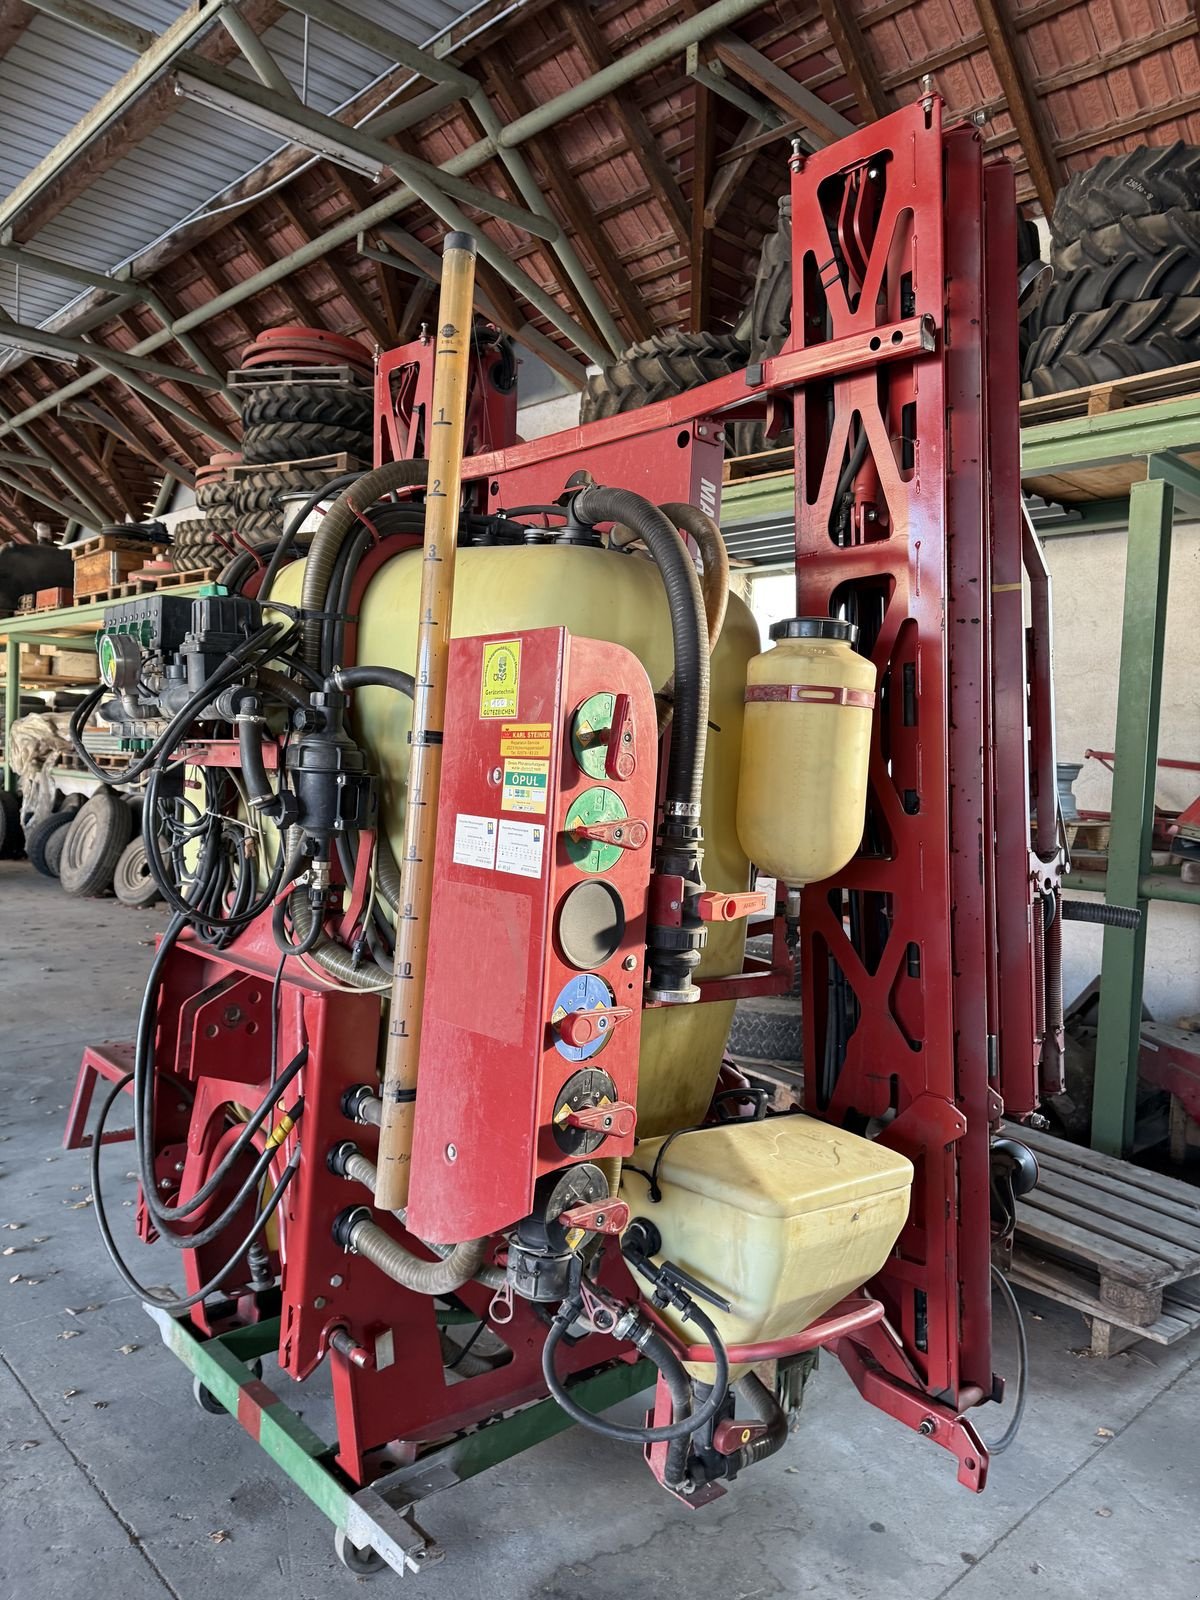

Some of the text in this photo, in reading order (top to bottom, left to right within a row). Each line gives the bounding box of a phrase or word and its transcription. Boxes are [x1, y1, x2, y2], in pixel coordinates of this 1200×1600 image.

[439, 408, 445, 421] 1
[433, 479, 441, 492] 2
[429, 544, 436, 557] 3
[426, 608, 432, 621] 4
[420, 671, 428, 684] 5
[512, 731, 526, 739] KARL
[512, 772, 539, 786] ÖPUL
[413, 789, 420, 801] 7
[409, 845, 416, 858] 8
[405, 904, 412, 916] 9
[397, 962, 412, 976] 10
[393, 1020, 406, 1034] 11
